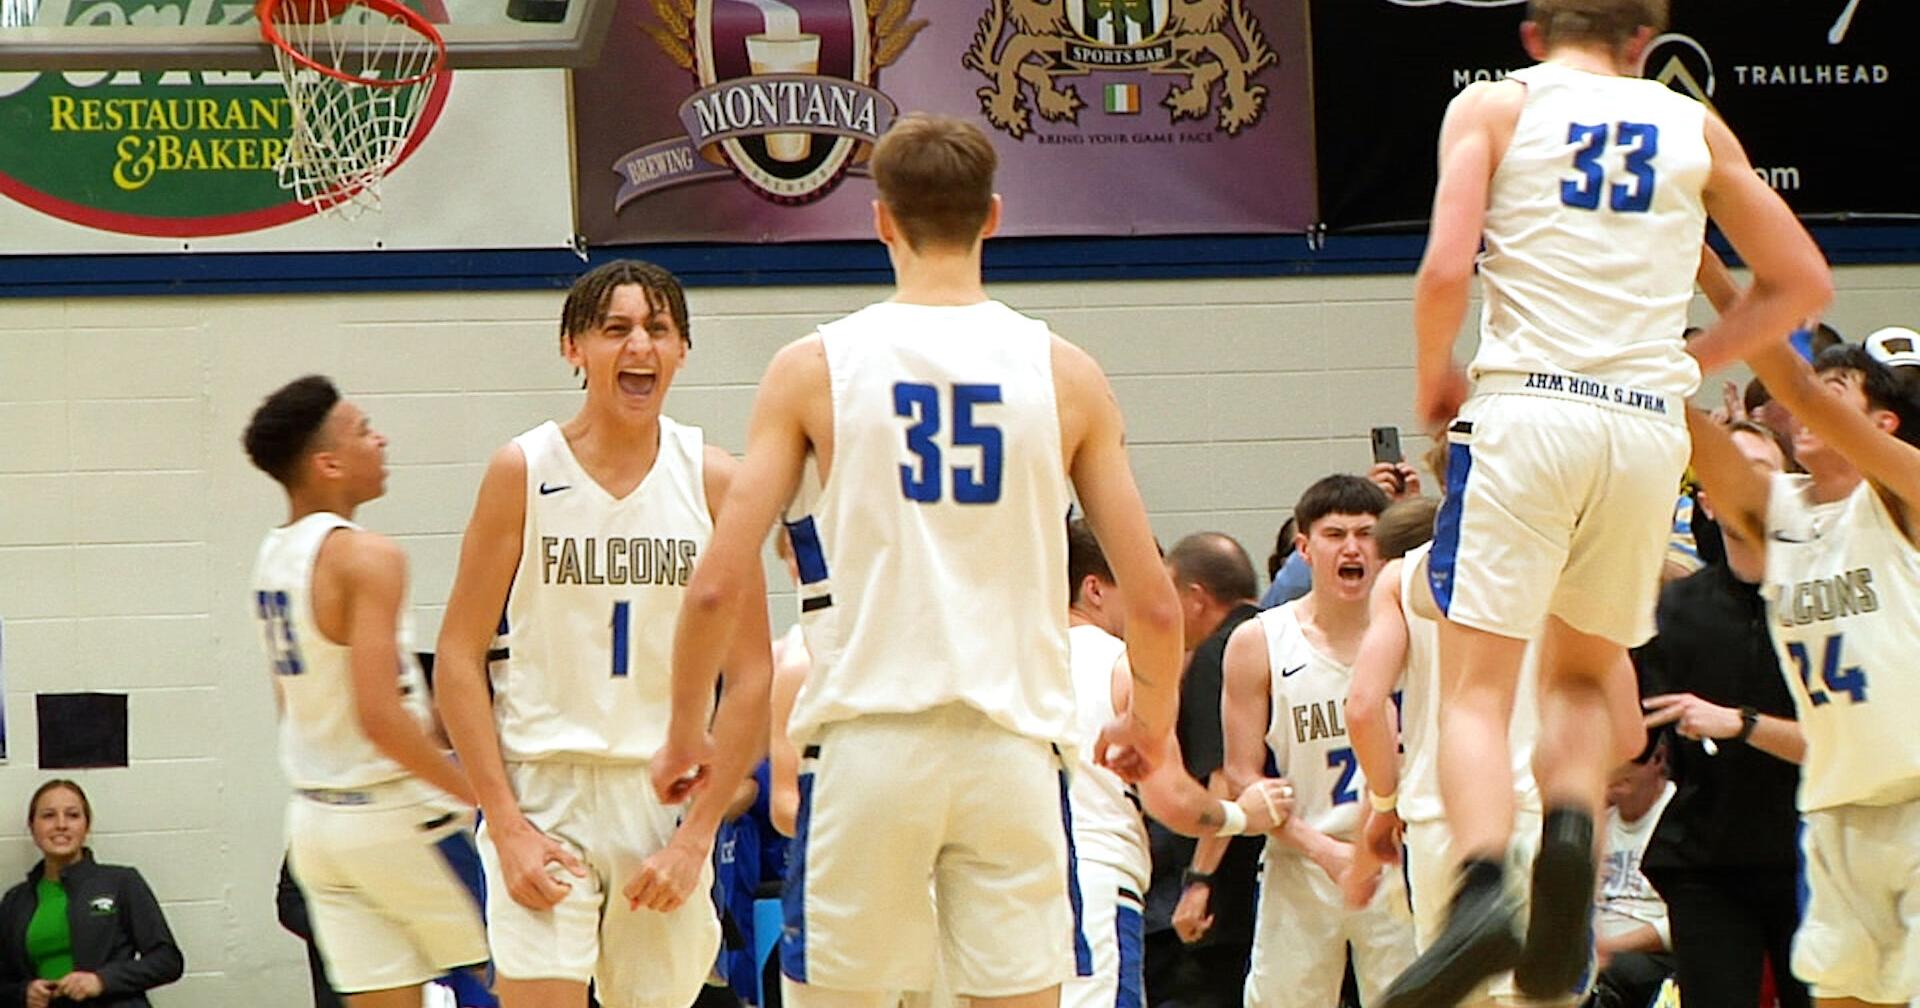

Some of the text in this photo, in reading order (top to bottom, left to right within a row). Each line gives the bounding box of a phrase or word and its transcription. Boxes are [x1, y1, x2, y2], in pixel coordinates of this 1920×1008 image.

[1073, 47, 1165, 63] SPORTS BAR
[1734, 65, 1889, 84] TRAILHEAD
[1453, 69, 1511, 88] MON
[693, 82, 878, 137] MONTANA
[1038, 132, 1213, 144] BRING YOUR GAME FACE
[627, 147, 693, 185] BREWING
[1560, 121, 1658, 212] 33
[1524, 372, 1564, 391] WHY
[1569, 376, 1609, 400] YOUR
[893, 382, 1003, 504] 35
[541, 536, 697, 585] FALCONS
[611, 601, 629, 677] 1
[1785, 633, 1869, 707] 24
[1293, 698, 1348, 743] FAL
